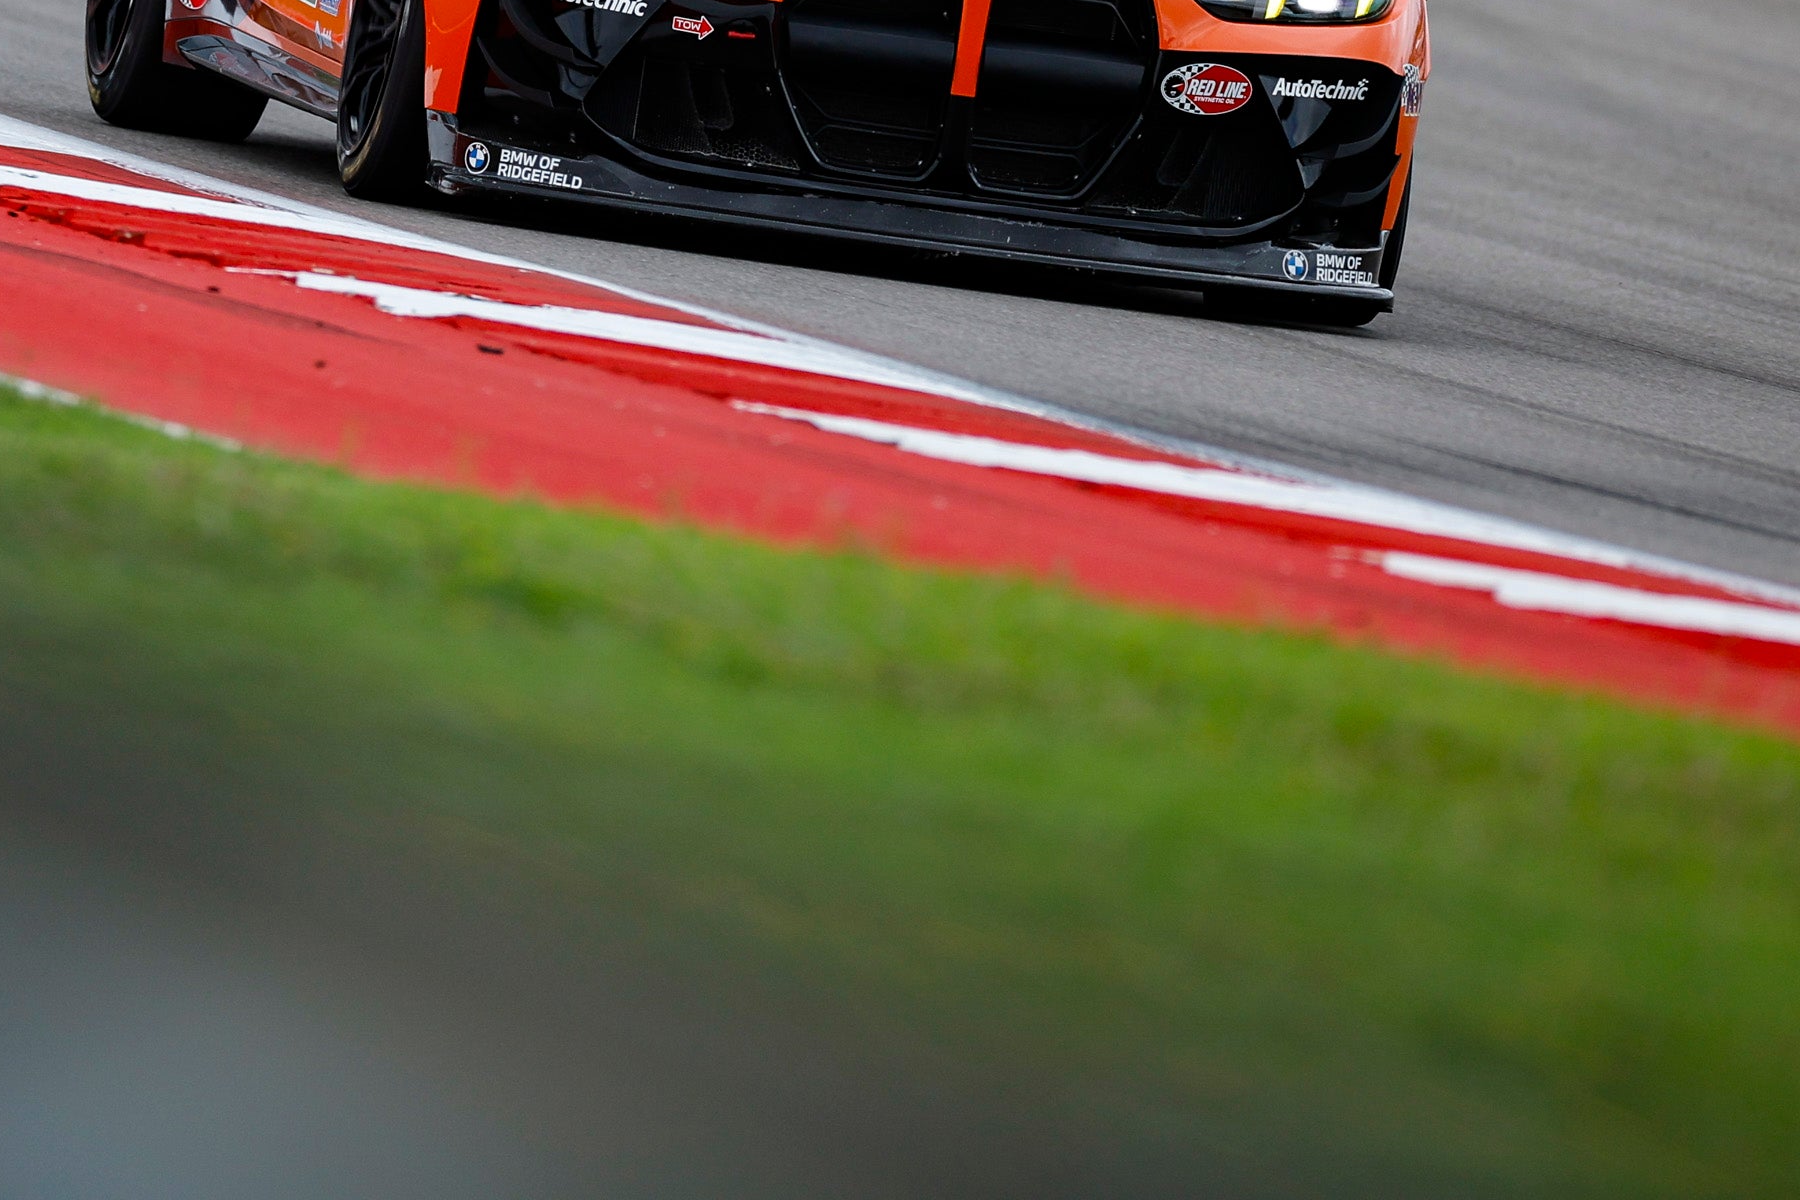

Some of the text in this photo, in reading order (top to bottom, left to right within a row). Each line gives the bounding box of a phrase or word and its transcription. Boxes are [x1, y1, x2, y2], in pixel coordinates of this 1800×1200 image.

[675, 19, 701, 31] TOW
[1187, 78, 1247, 99] RED LINE
[1272, 77, 1369, 101] AutoTechnic
[1194, 96, 1223, 104] SYNTHETIC
[500, 149, 561, 171] BMW OF
[497, 163, 583, 189] RIDGEFIELD
[1316, 253, 1362, 270] BMW OF
[1316, 267, 1373, 285] RIDGEFIELD
